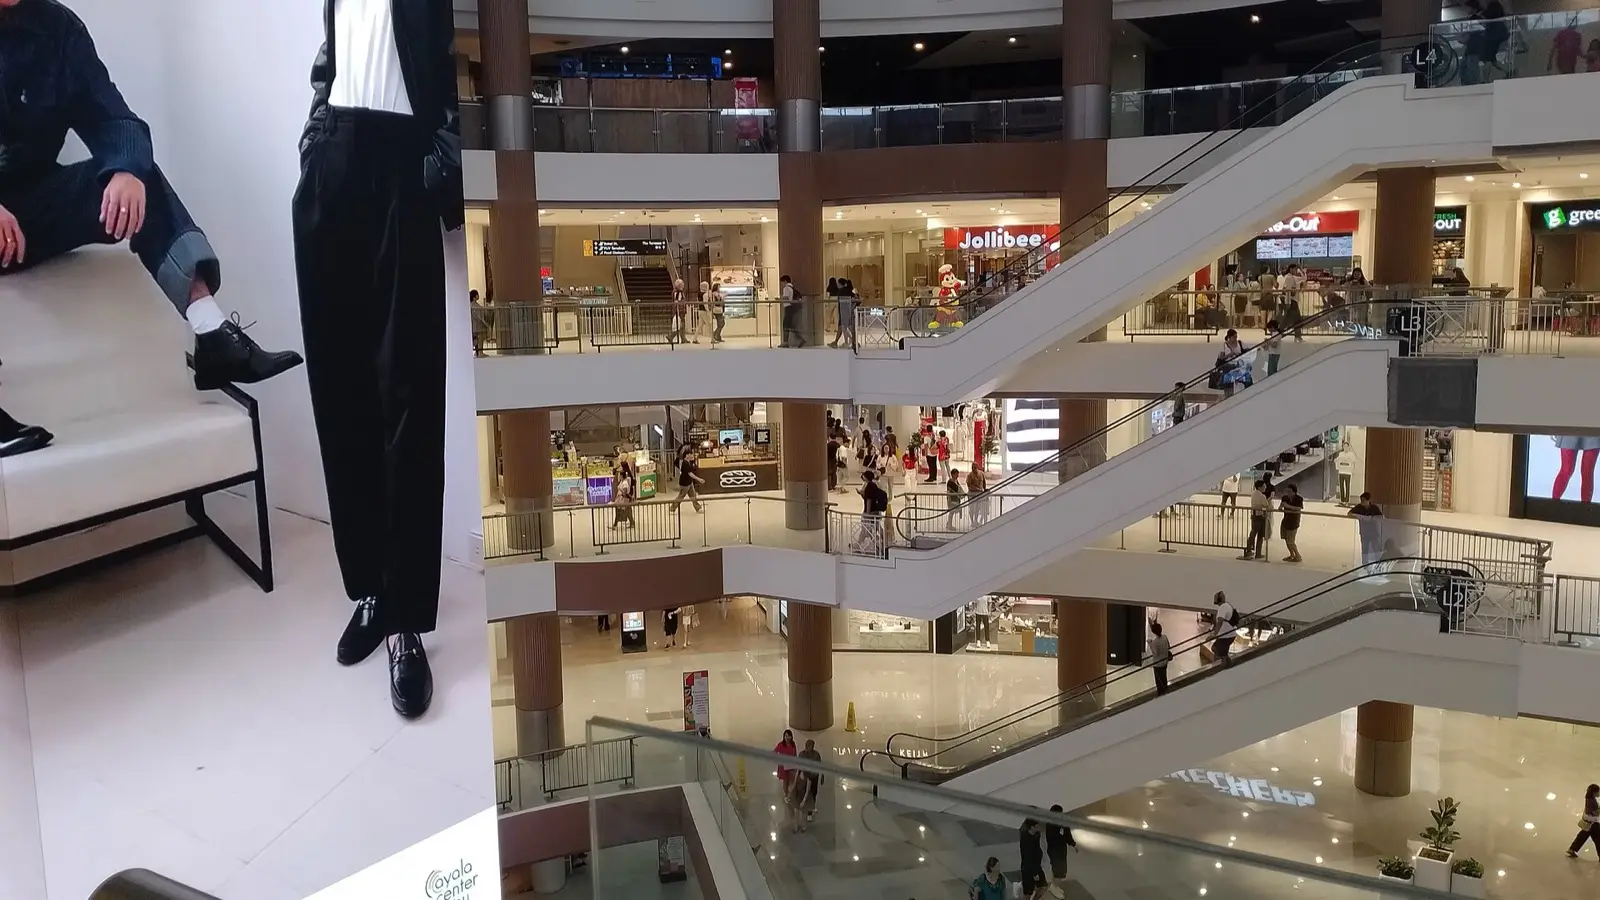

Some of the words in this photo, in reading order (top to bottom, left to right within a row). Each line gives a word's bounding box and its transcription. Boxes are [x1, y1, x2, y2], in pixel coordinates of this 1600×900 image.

[1416, 48, 1437, 65] L4
[959, 227, 1042, 249] Jollibee
[1400, 315, 1421, 331] L3
[1443, 590, 1464, 607] L2
[434, 858, 473, 889] ayala
